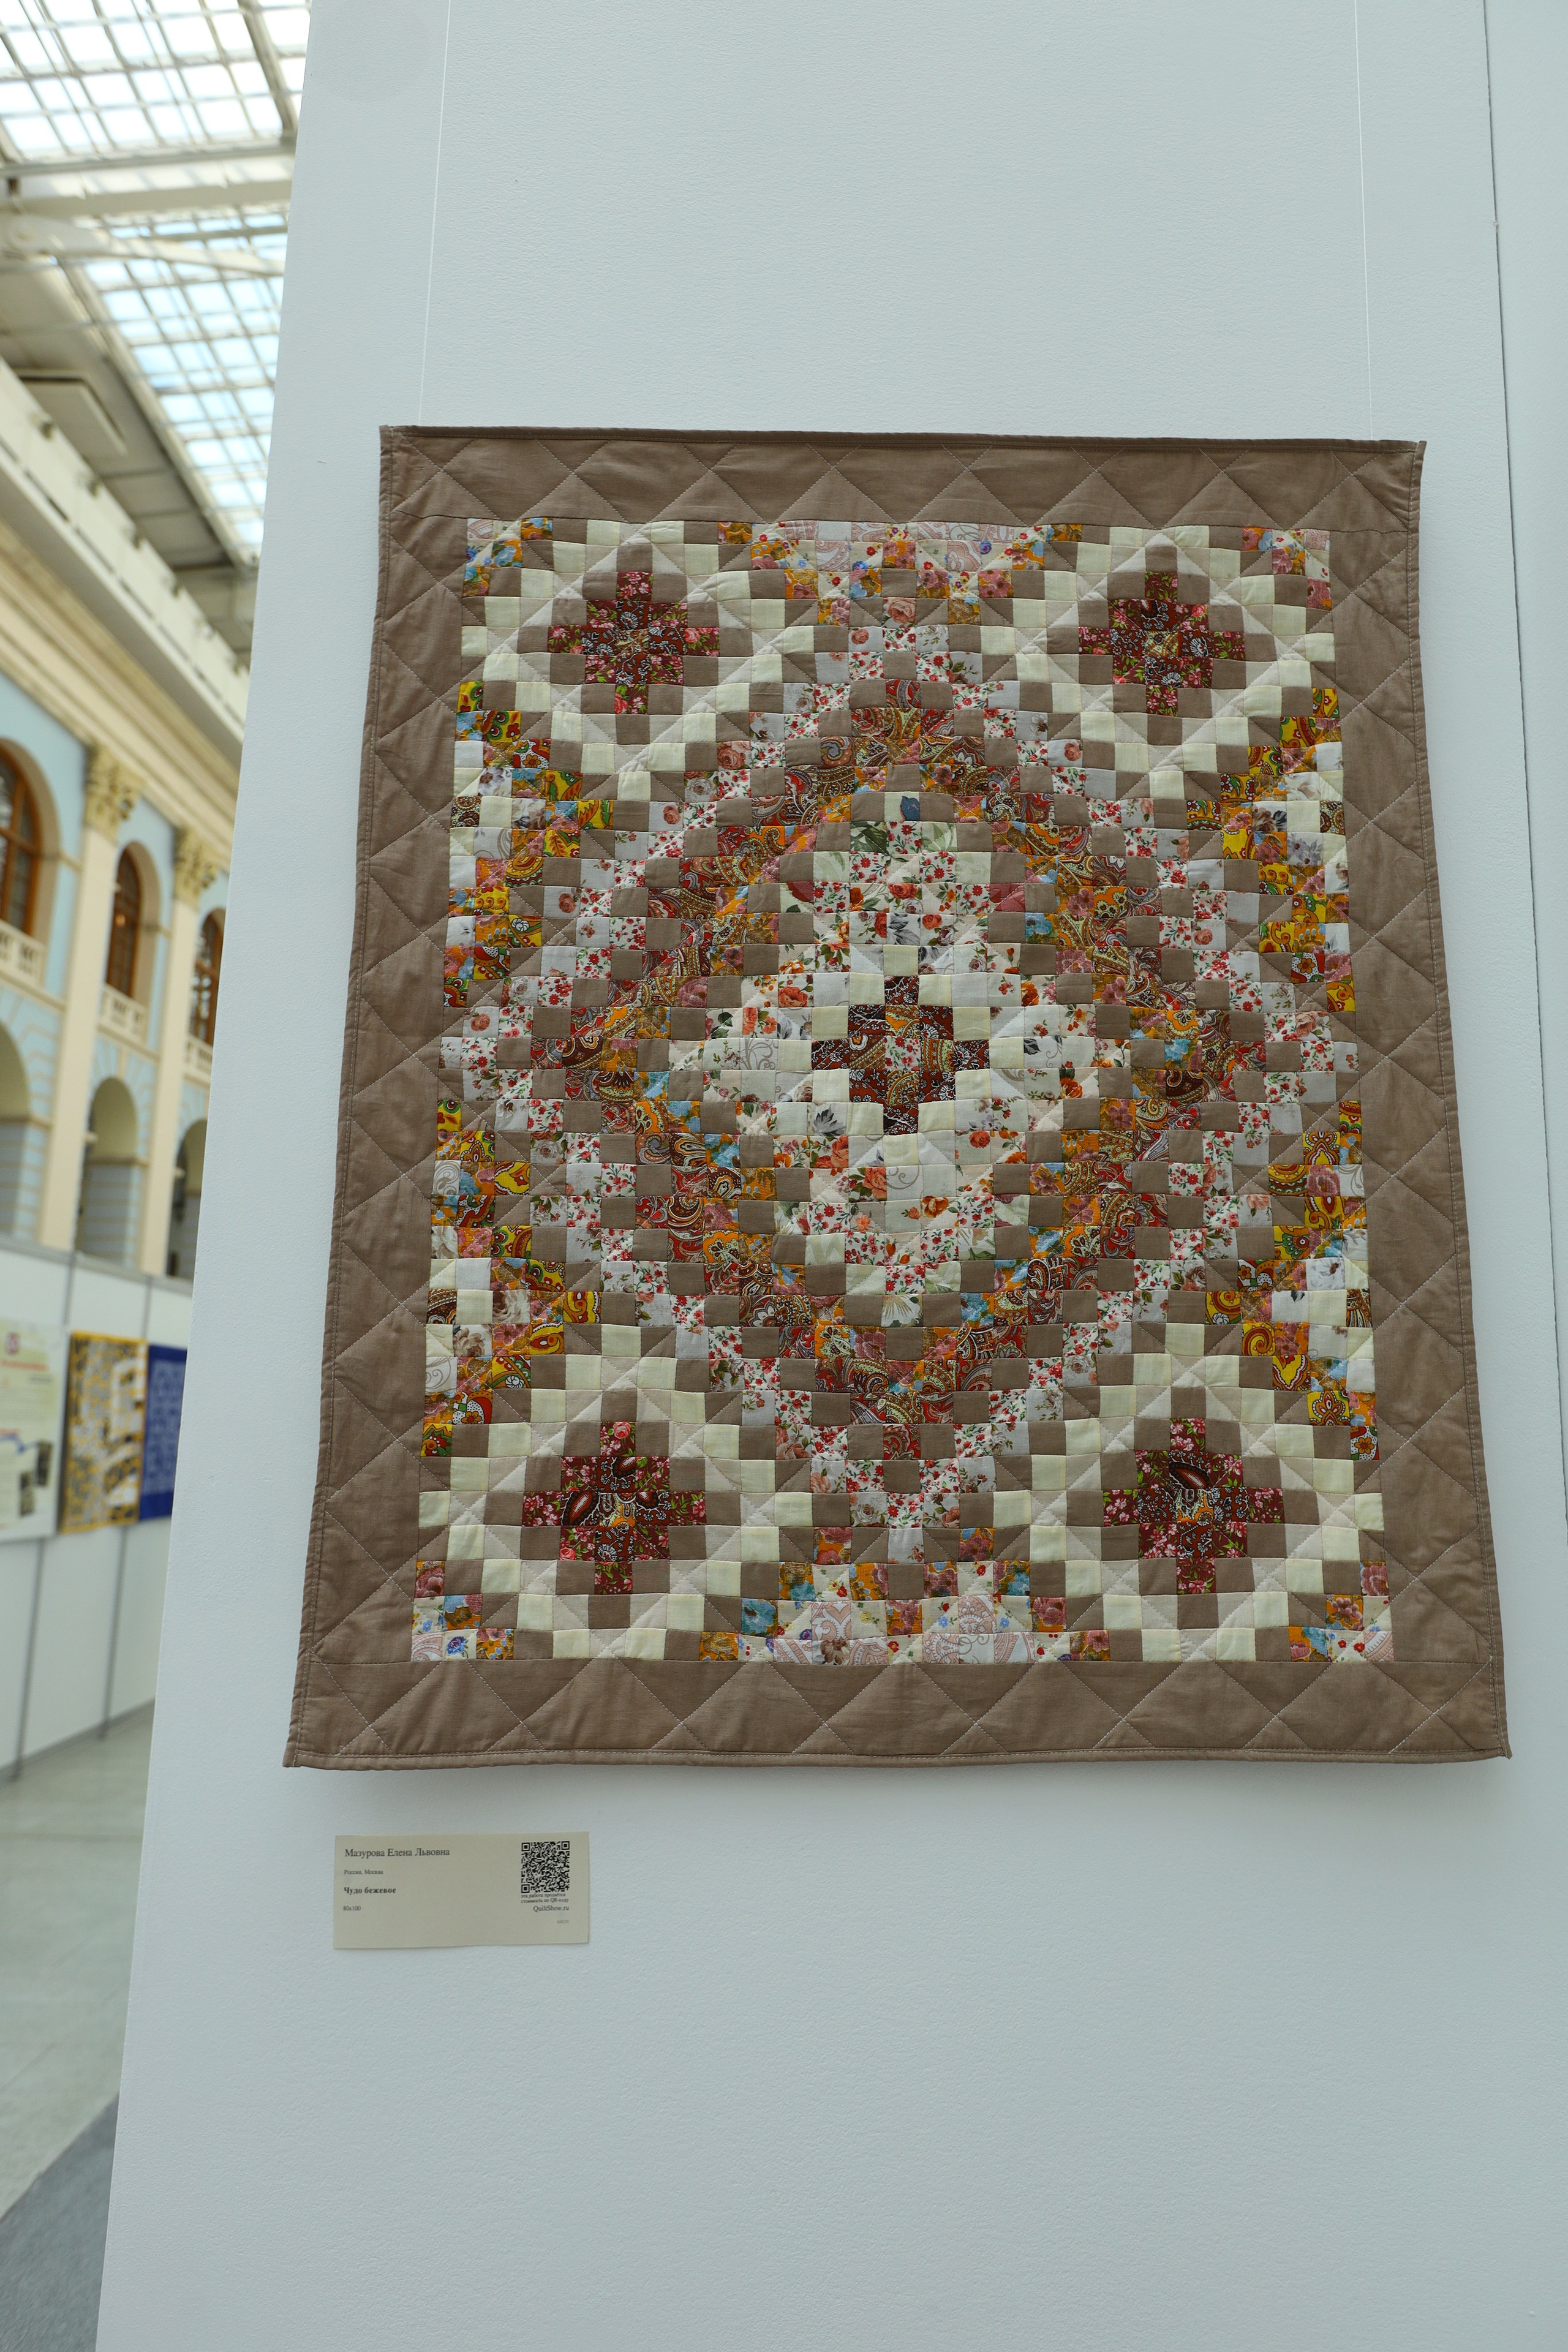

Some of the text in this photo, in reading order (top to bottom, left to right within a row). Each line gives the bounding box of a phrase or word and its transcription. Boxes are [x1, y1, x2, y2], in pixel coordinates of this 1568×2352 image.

[345, 1847, 450, 1859] Мазурова Елена Львовна
[344, 1887, 363, 1895] Чудо
